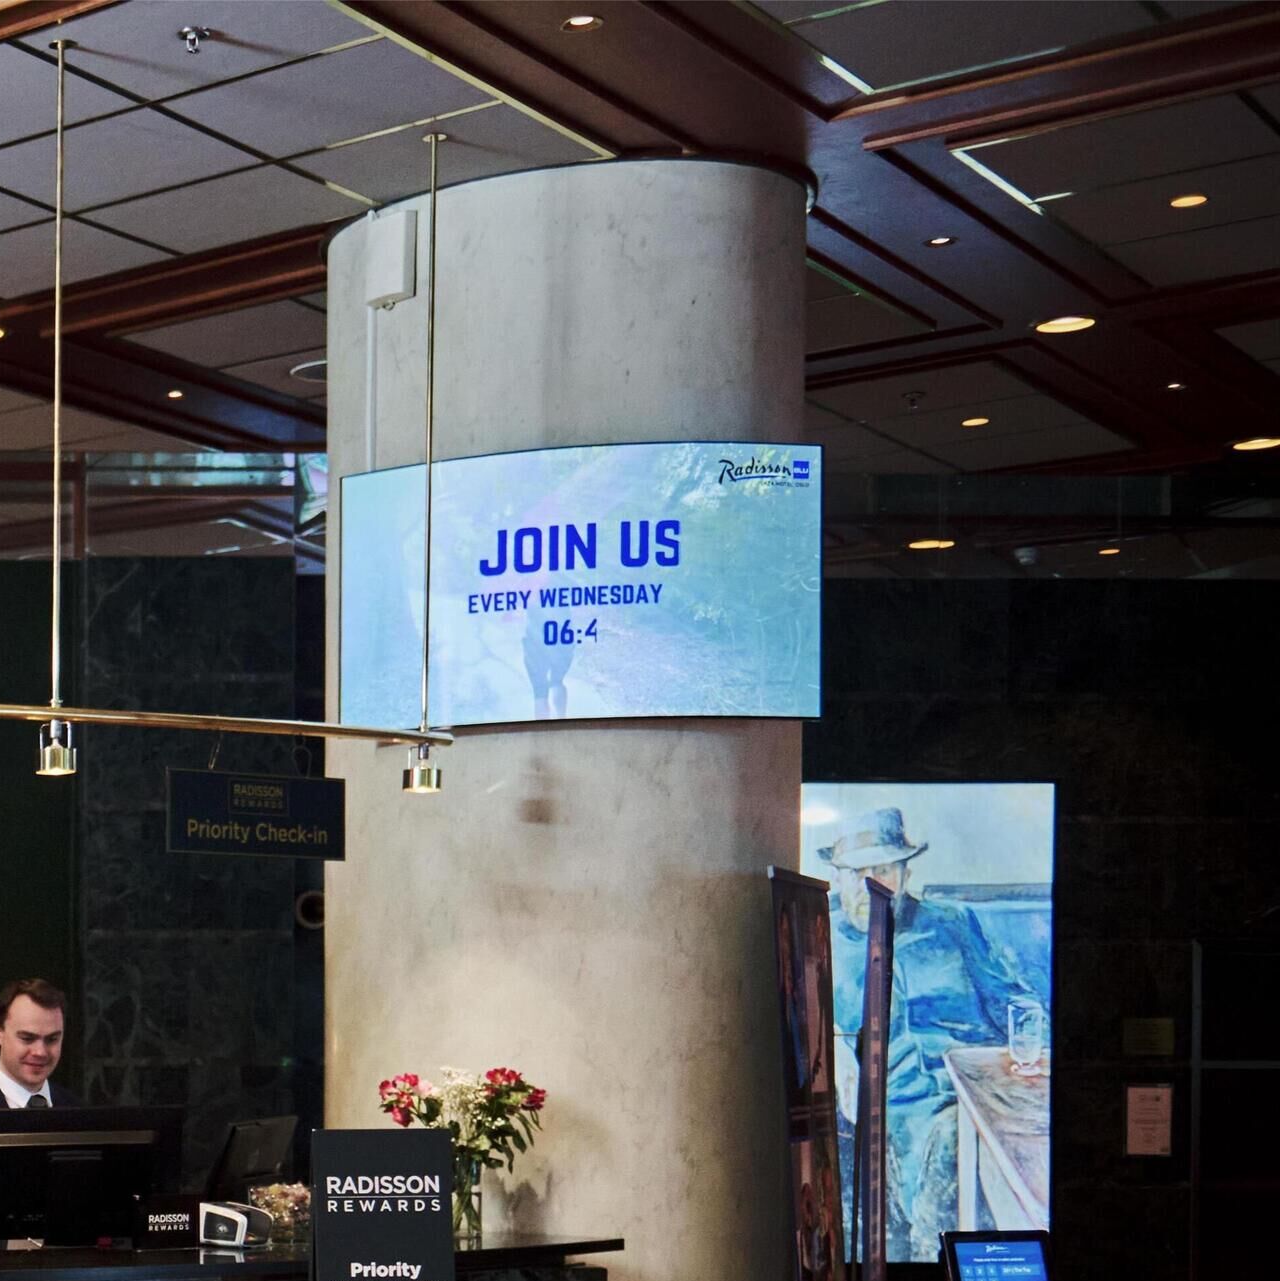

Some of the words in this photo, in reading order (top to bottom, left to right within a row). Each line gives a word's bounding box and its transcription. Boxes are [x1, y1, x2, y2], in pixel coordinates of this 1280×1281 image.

[719, 456, 791, 485] Radisson
[479, 522, 597, 576] JOIN
[620, 519, 680, 567] US
[468, 590, 531, 613] EVERY
[540, 583, 663, 608] WEDNESDAY
[233, 783, 284, 798] RADISSON
[187, 819, 250, 844] Priority
[255, 822, 328, 845] Check-in
[326, 1175, 440, 1195] RADISSON
[327, 1199, 441, 1212] REWARDS
[148, 1213, 190, 1224] RADISSON
[148, 1224, 190, 1232] REWARDS
[350, 1262, 422, 1280] Priority
